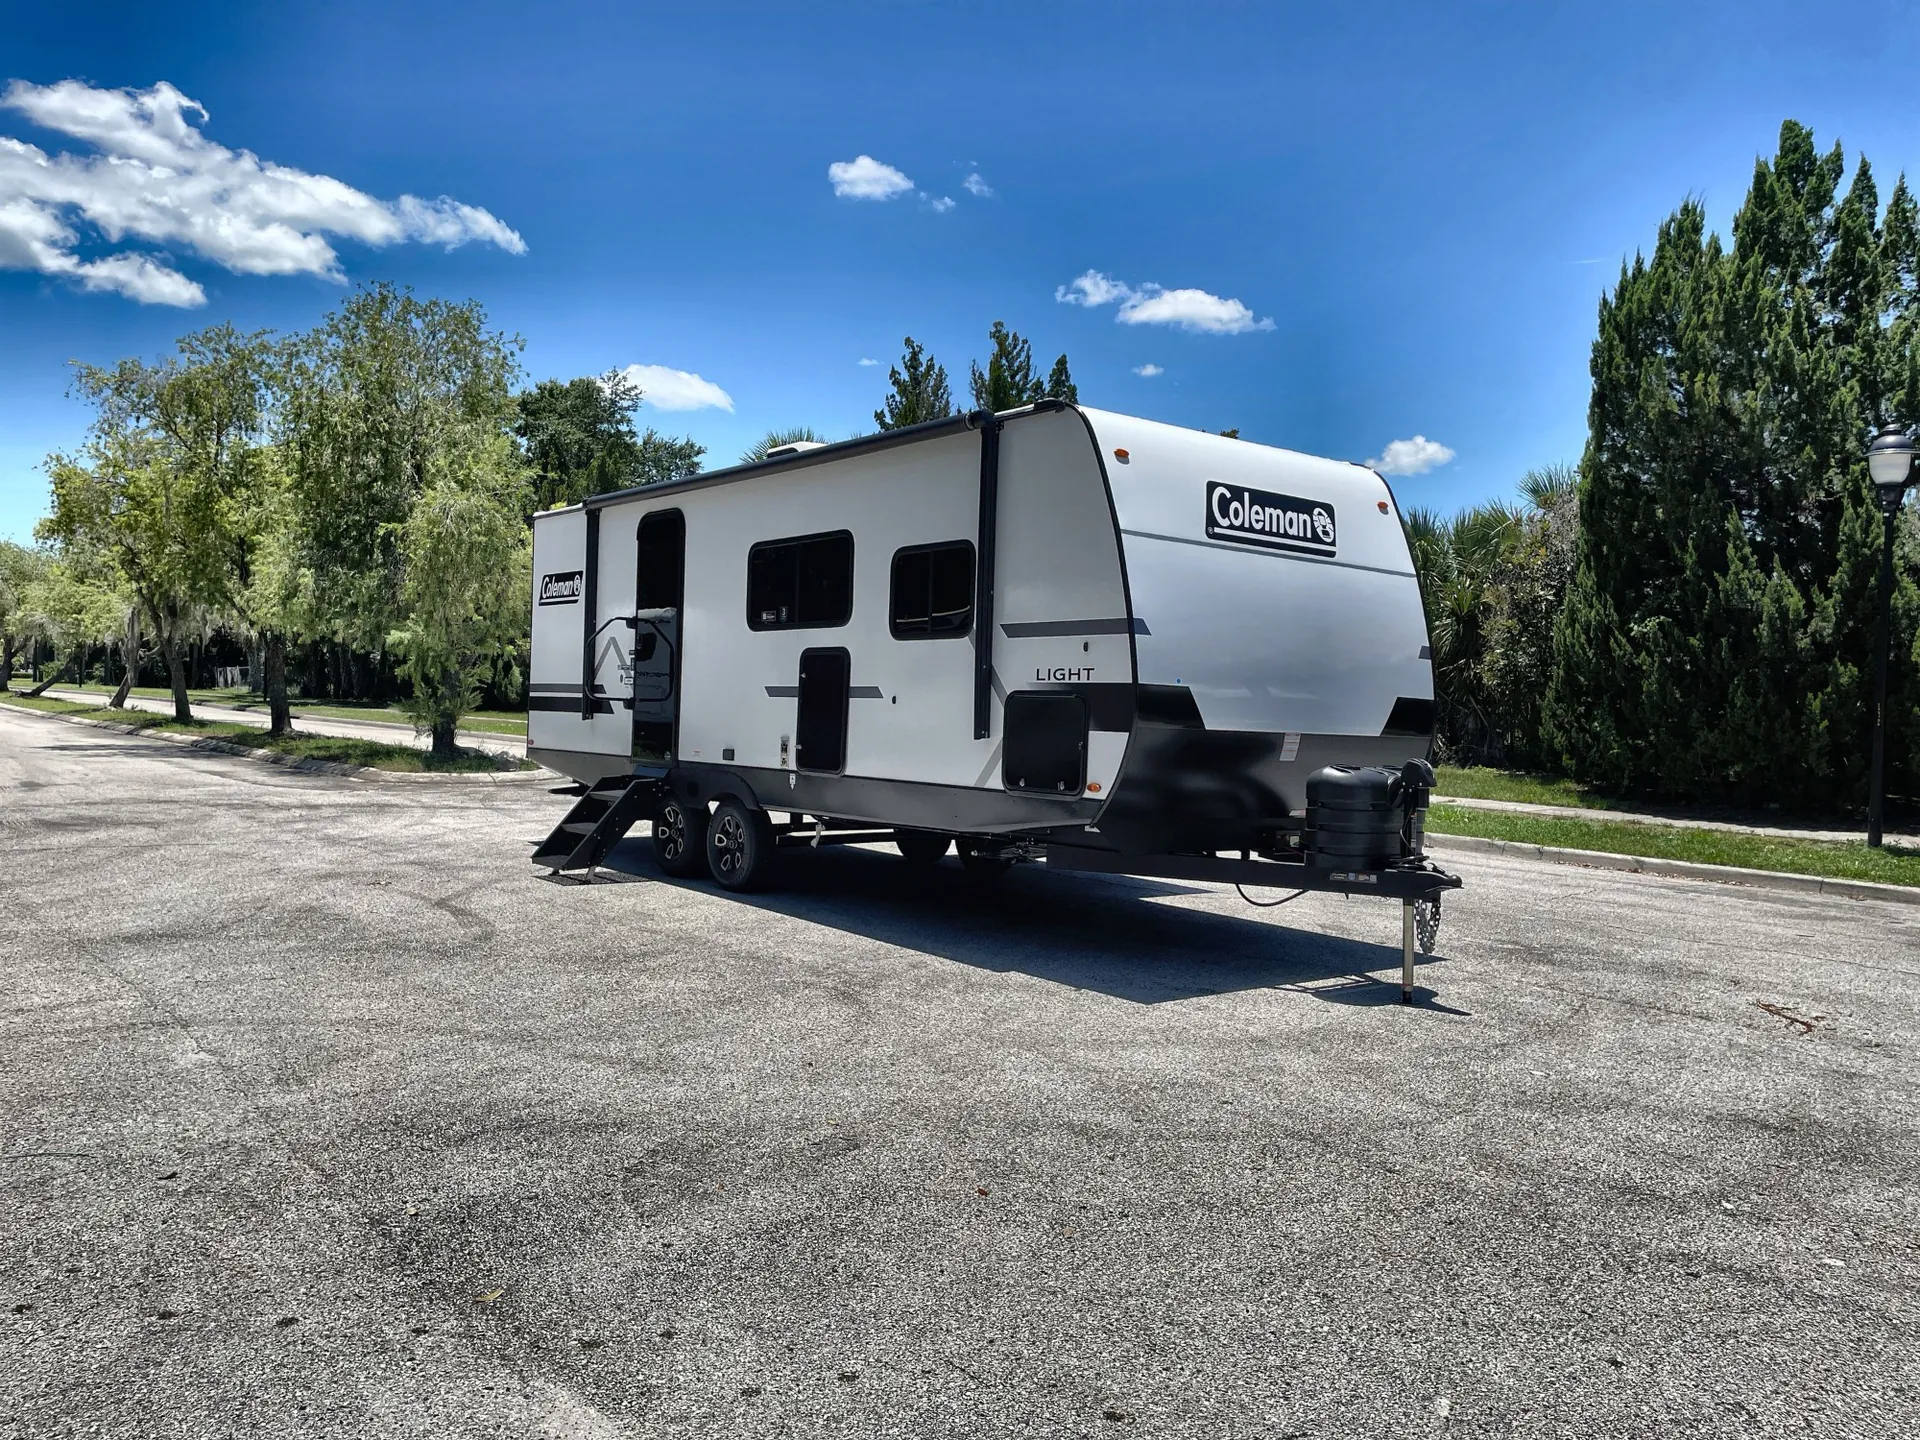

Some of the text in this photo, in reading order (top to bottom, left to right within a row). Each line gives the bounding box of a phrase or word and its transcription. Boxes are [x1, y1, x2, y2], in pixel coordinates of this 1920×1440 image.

[1211, 486, 1312, 538] Coleman
[542, 576, 574, 598] Coleman
[1036, 668, 1095, 681] LIGHT
